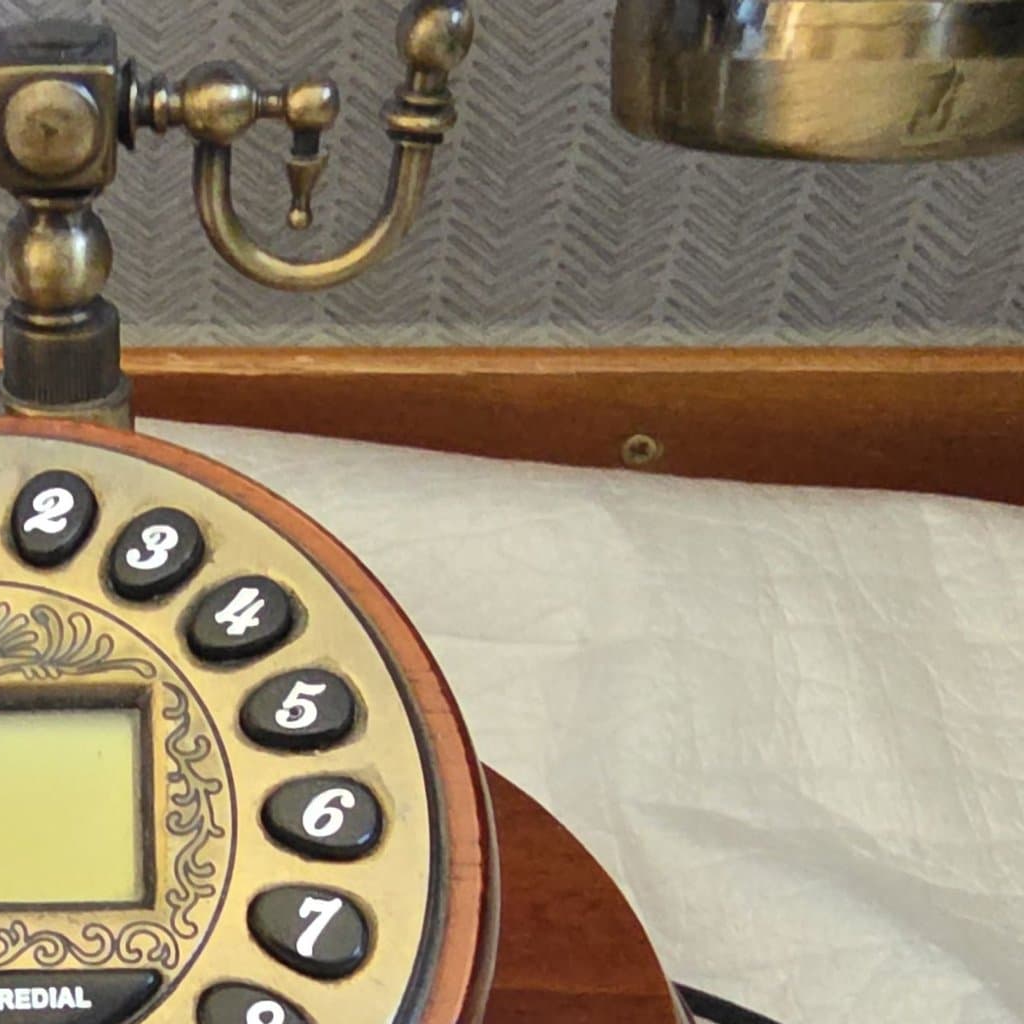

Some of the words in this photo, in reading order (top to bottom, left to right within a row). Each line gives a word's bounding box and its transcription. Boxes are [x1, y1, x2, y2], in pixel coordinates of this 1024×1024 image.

[23, 487, 75, 534] 2
[125, 524, 179, 570] 3
[214, 587, 265, 636] 4
[274, 680, 327, 730] 5
[301, 787, 356, 838] 6
[295, 896, 343, 958] 7
